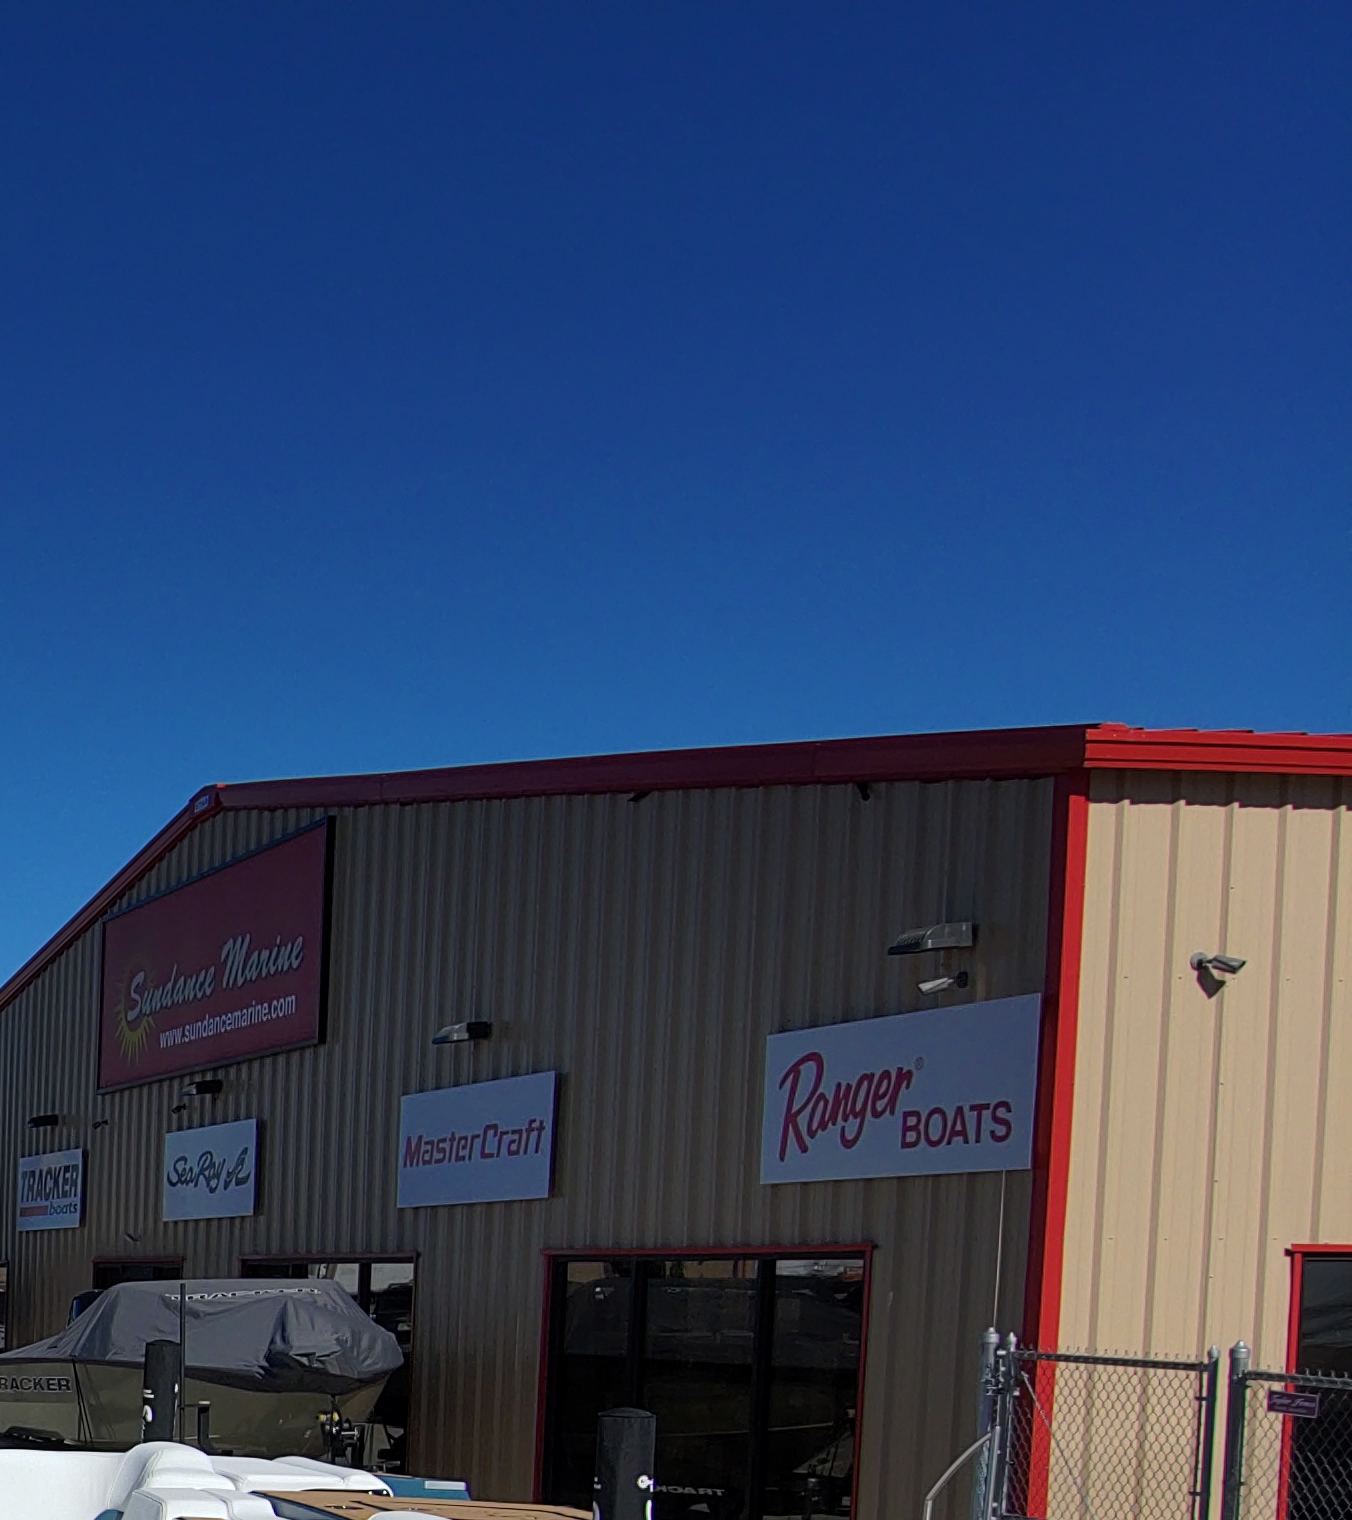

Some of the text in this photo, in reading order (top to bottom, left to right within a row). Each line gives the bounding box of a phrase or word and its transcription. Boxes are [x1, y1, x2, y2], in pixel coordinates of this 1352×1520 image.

[127, 933, 304, 1021] Sundance Marine
[159, 993, 296, 1049] www.sundancemarine.com
[401, 1116, 548, 1169] MasterCraft
[900, 1101, 1013, 1149] BOATS
[20, 1163, 79, 1203] TRACKER
[48, 1201, 78, 1216] boats
